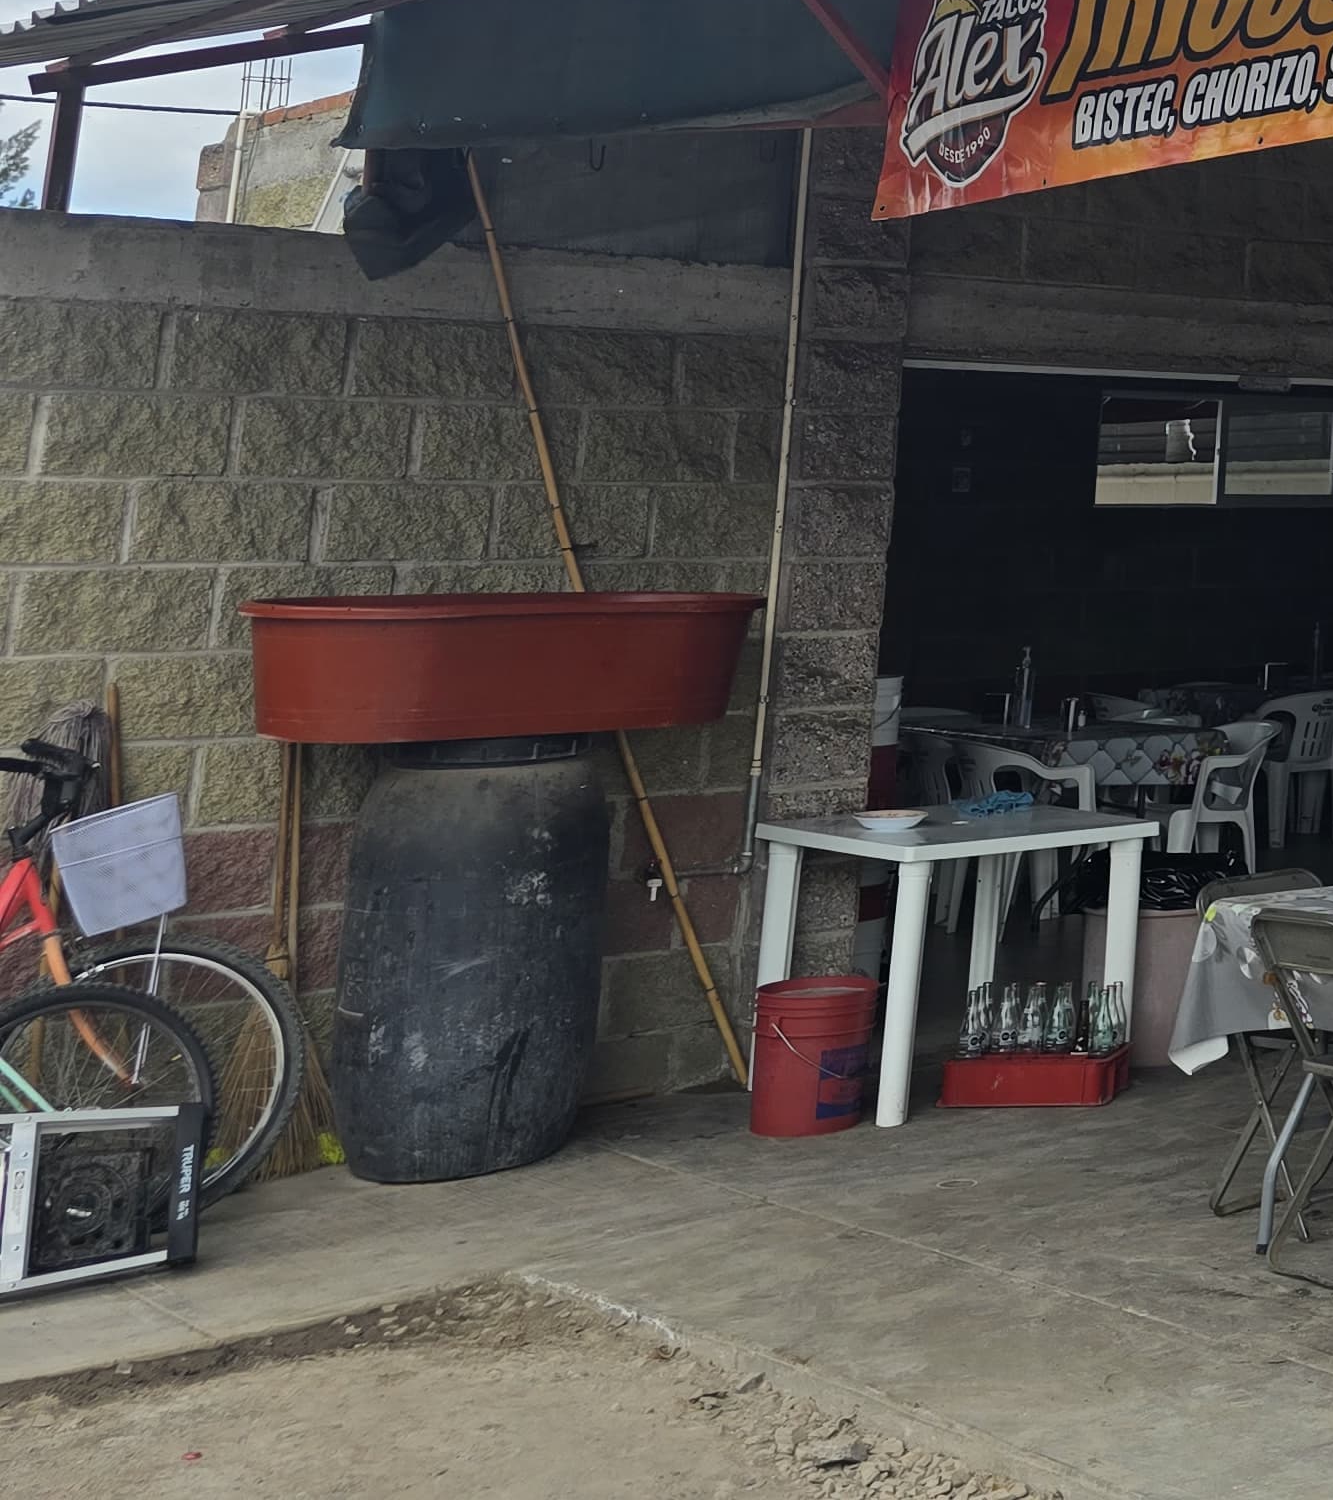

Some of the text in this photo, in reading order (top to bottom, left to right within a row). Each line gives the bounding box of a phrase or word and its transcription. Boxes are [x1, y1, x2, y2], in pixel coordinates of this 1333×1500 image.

[907, 13, 1044, 128] Alex
[1074, 80, 1176, 145] BISTEC,
[1181, 51, 1318, 126] CHORIZO,
[938, 125, 992, 164] DESDE 1990
[178, 1143, 195, 1195] TRUPER
